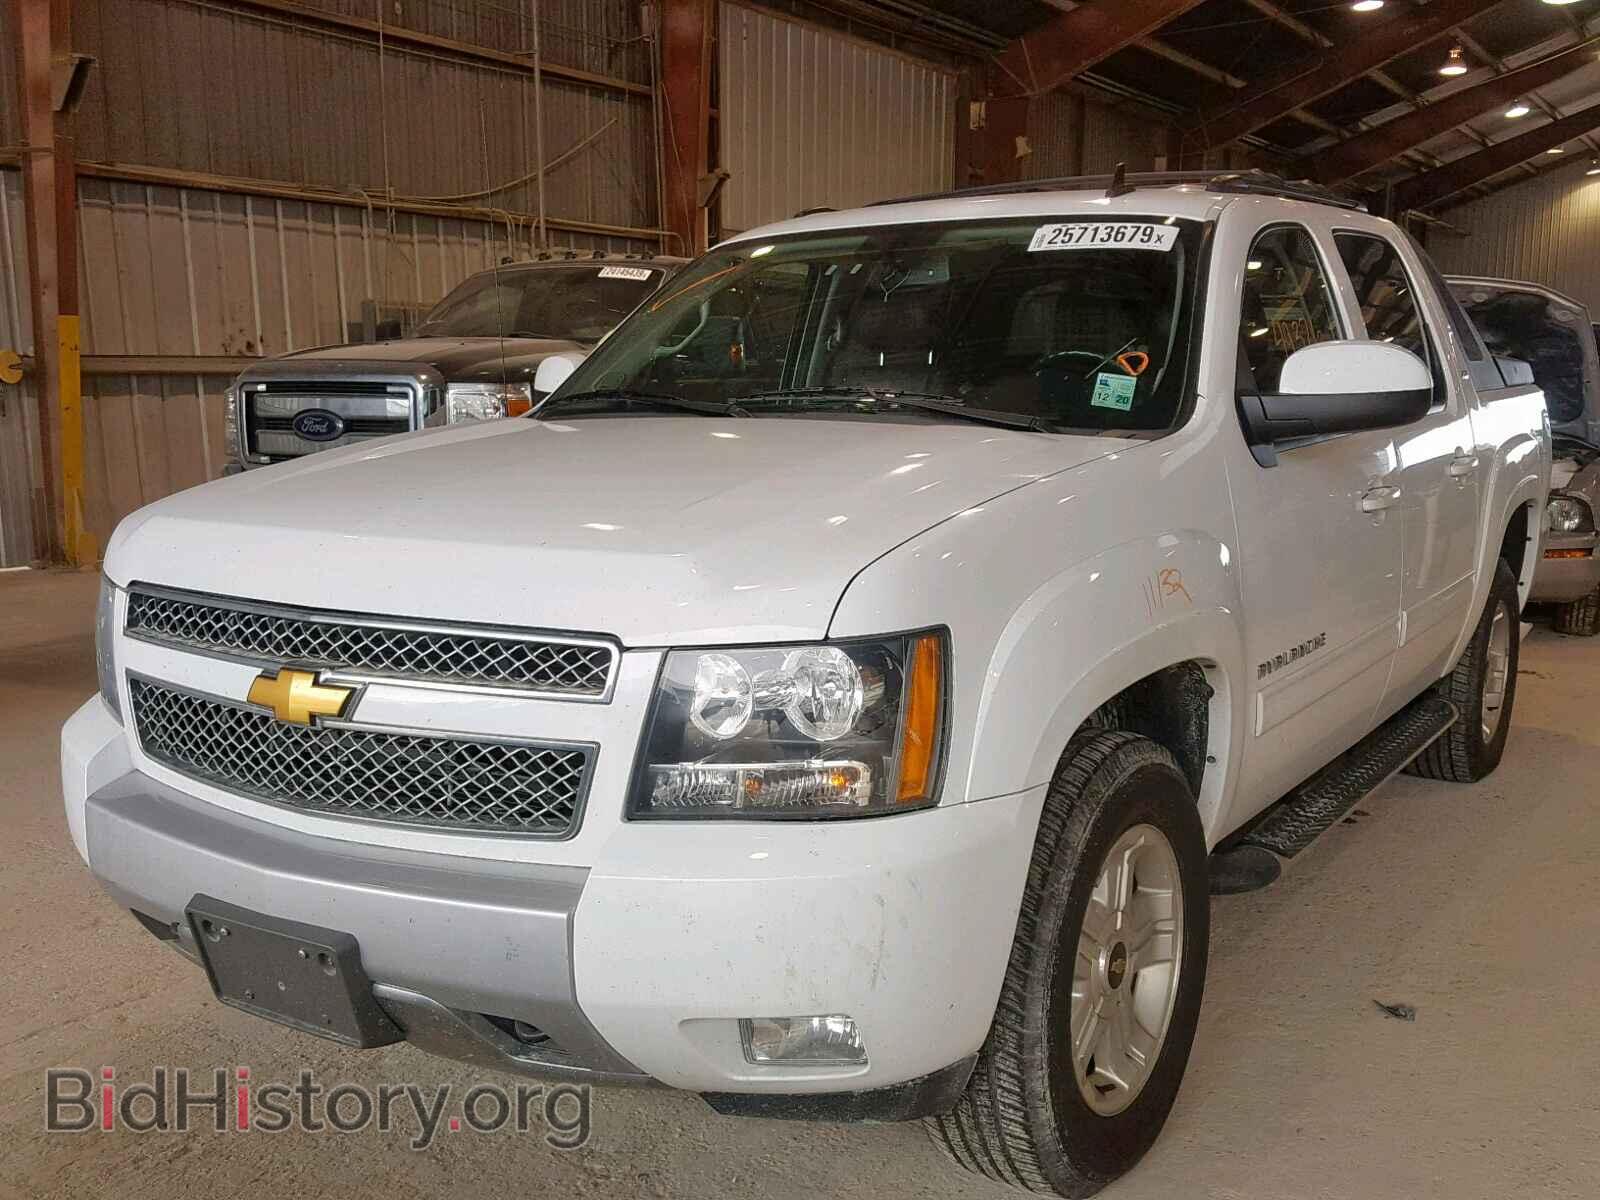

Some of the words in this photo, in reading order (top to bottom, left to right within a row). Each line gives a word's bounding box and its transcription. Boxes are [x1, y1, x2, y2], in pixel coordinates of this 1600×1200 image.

[1097, 392, 1110, 401] 12
[1116, 394, 1129, 405] 20
[301, 416, 329, 433] Ford
